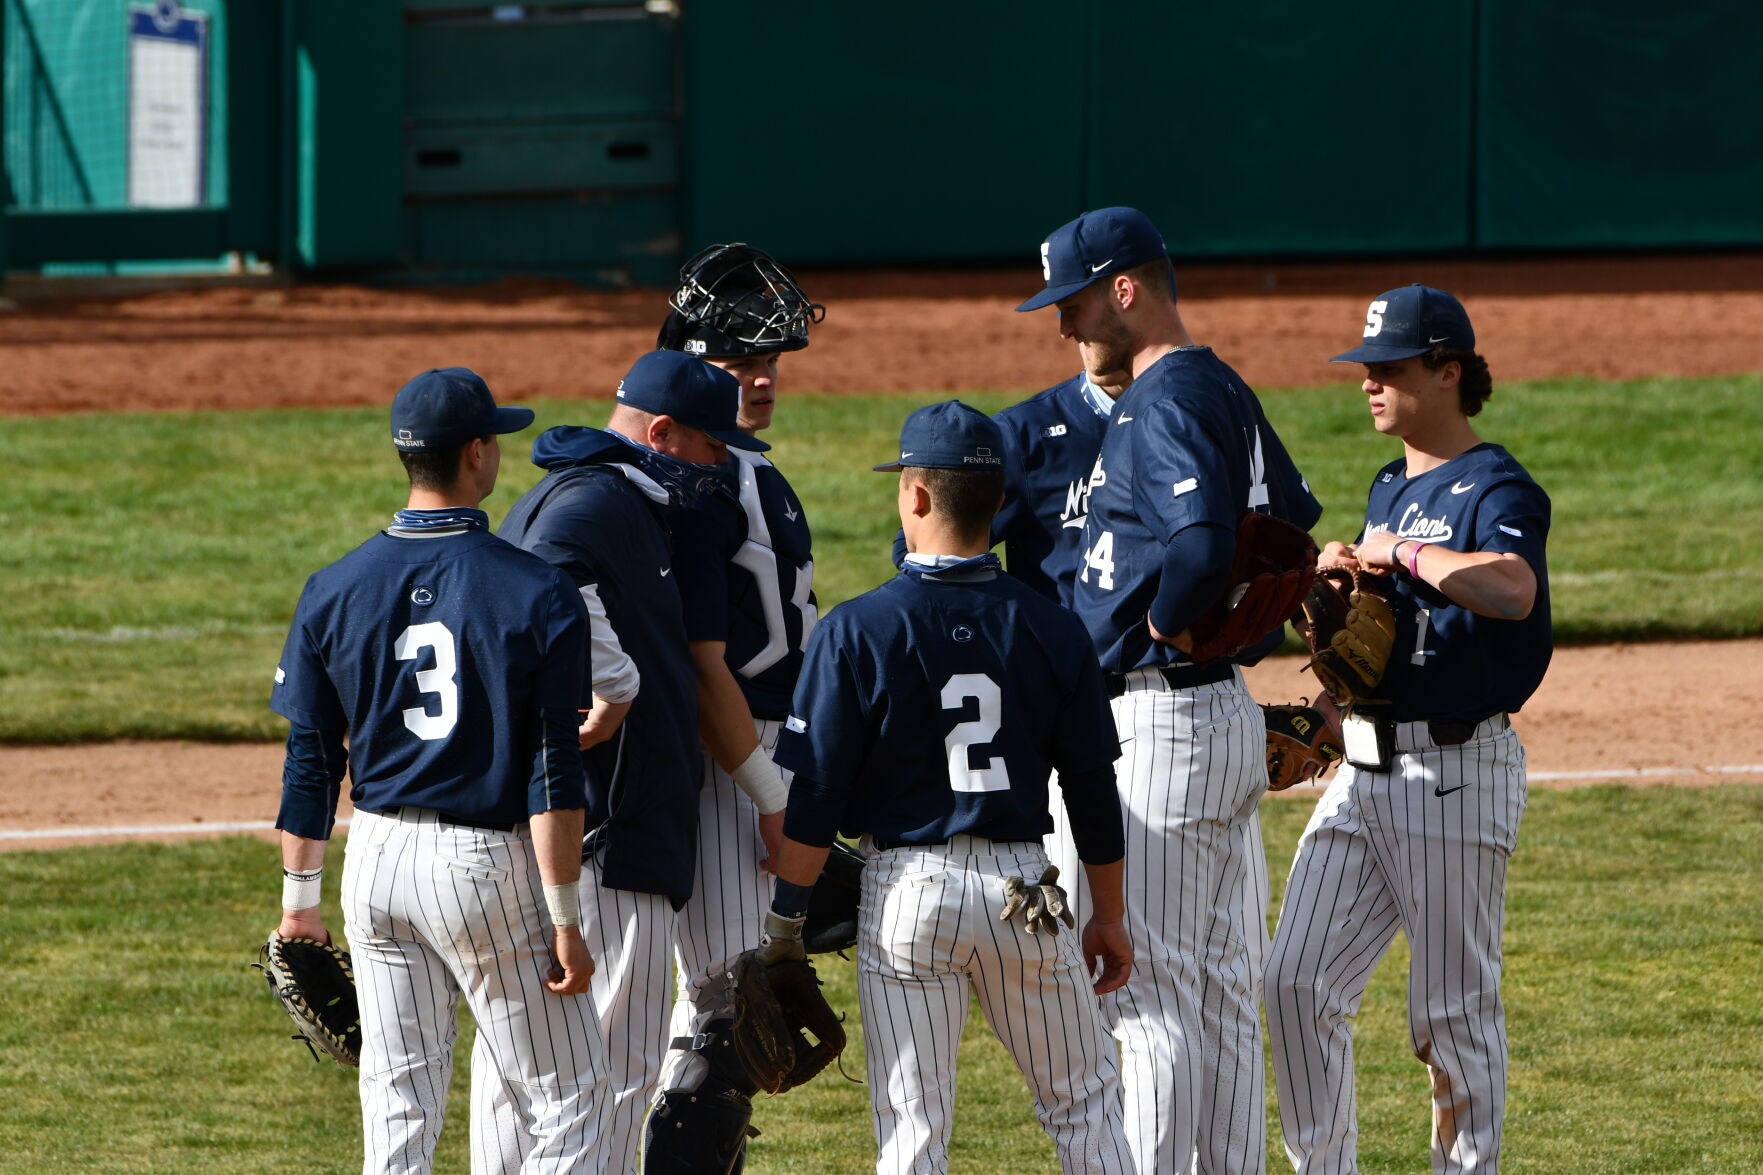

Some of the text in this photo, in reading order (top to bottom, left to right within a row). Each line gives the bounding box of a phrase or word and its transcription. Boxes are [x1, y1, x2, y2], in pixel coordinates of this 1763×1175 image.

[1363, 300, 1388, 338] S
[963, 456, 1001, 465] PENN STATE
[1396, 502, 1452, 541] Lions
[1409, 608, 1430, 667] 1
[394, 621, 458, 741] 3
[940, 673, 1011, 794] 2
